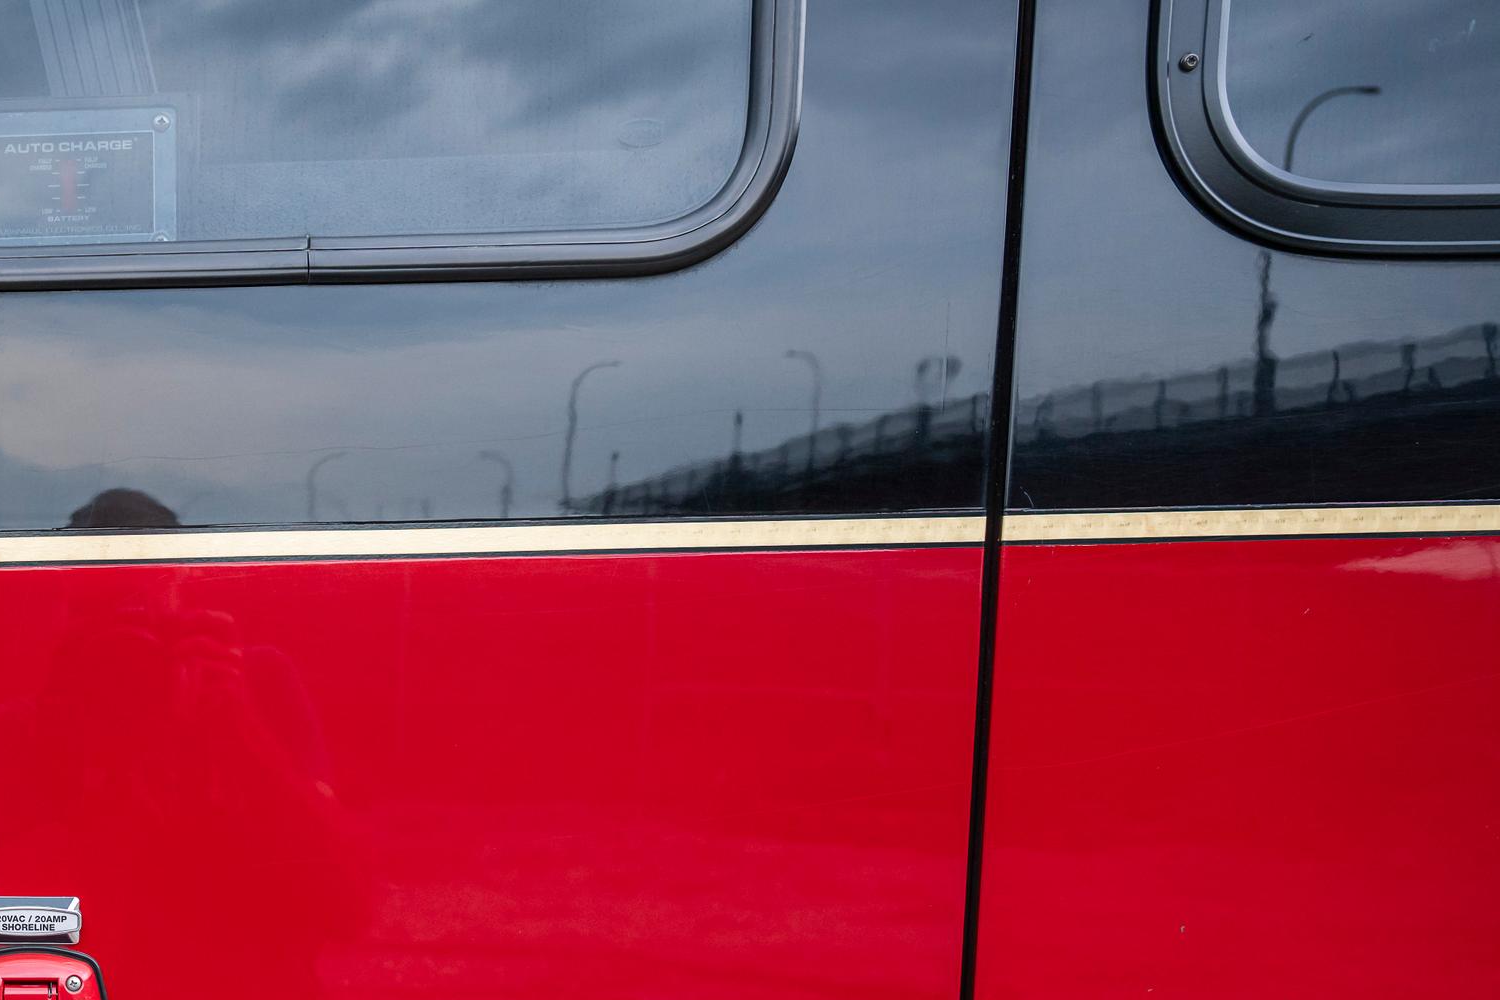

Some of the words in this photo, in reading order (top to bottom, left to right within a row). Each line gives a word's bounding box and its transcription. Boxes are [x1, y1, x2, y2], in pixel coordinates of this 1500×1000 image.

[4, 142, 54, 154] AUTO
[58, 139, 133, 152] CHARGE
[35, 915, 67, 923] 20AMP
[2, 923, 55, 931] SHORELINE
